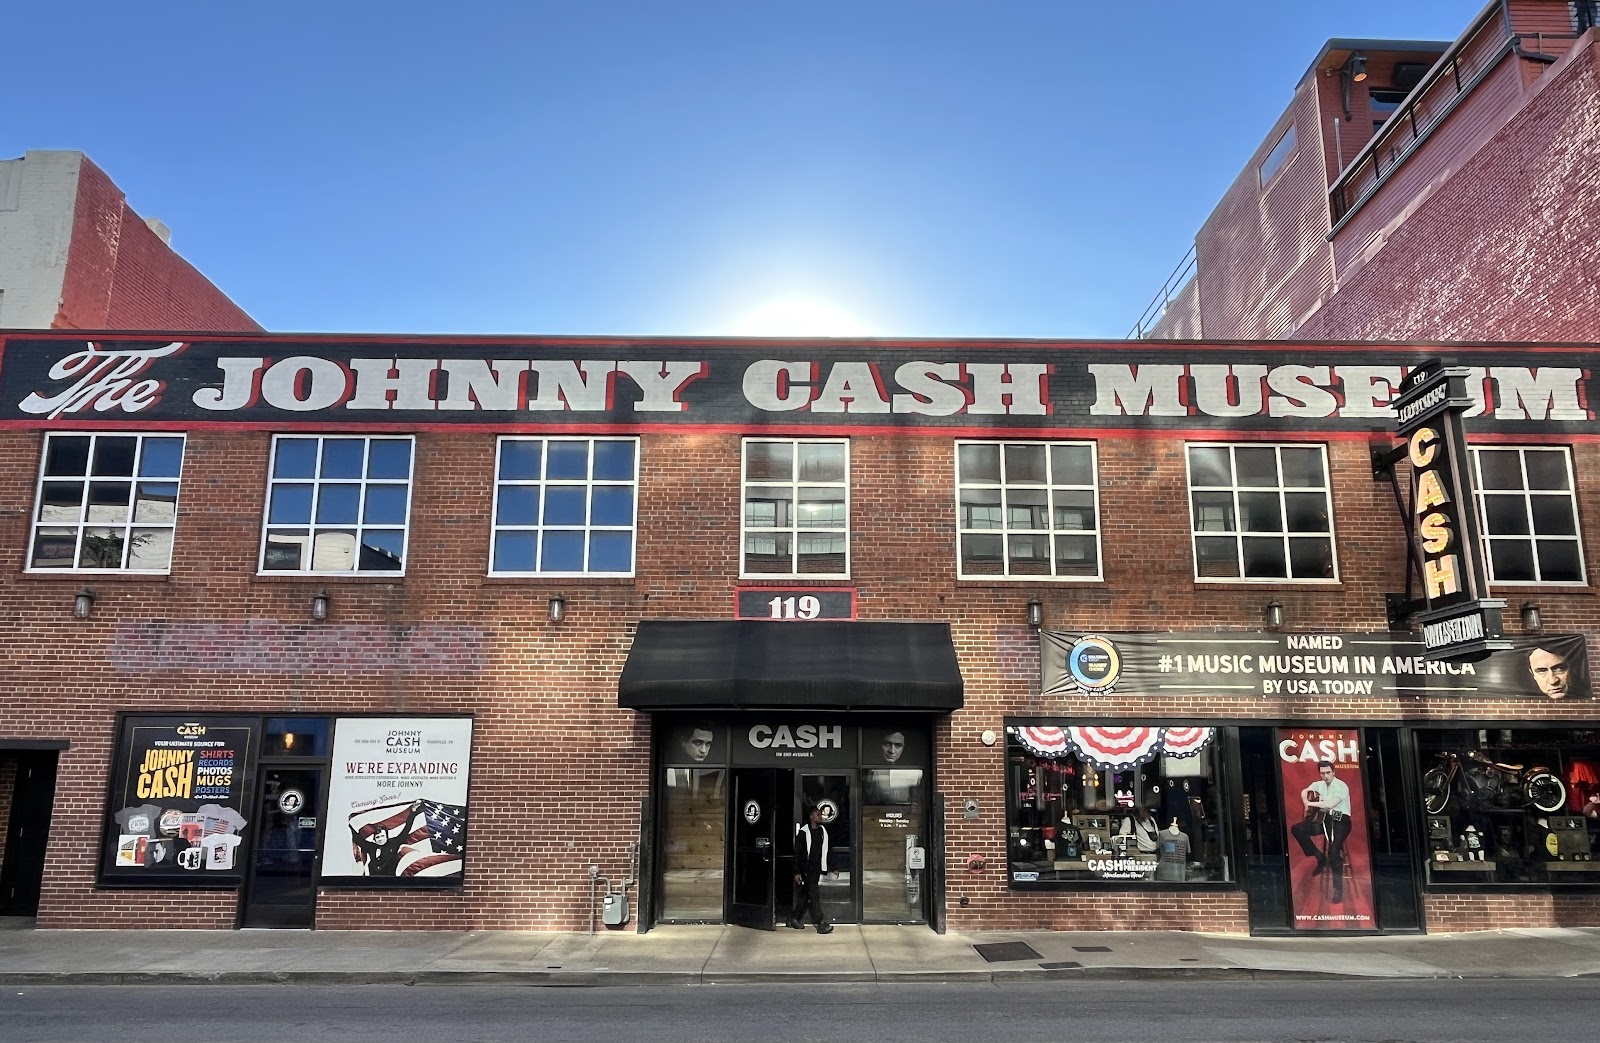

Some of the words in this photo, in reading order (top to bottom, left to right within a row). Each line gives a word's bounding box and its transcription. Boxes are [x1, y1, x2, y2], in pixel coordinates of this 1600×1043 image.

[18, 342, 183, 420] The
[192, 355, 702, 411] JOHNNY
[743, 360, 1048, 416] CASH
[1410, 427, 1460, 600] CASH
[768, 595, 820, 619] 119
[1286, 636, 1342, 650] NAMED
[1158, 655, 1183, 674] #1
[1188, 655, 1254, 674] MUSIC
[1259, 656, 1349, 674] MUSEUM
[1354, 656, 1375, 674] IN
[1381, 656, 1476, 675] AMERICA
[1262, 680, 1282, 694] BY
[1286, 680, 1318, 694] USA
[1322, 680, 1374, 694] TODAY
[177, 726, 206, 734] CASH
[748, 724, 842, 748] CASH
[386, 736, 420, 746] CASH
[200, 750, 234, 759] SHIRTS
[1279, 739, 1358, 763] CASH
[140, 750, 195, 774] JOHNNY
[346, 762, 384, 774] WE'RE
[388, 762, 458, 774] EXPANDING
[197, 767, 234, 776] PHOTOS
[136, 762, 194, 799] CASH
[196, 776, 232, 786] MUGS
[195, 786, 230, 794] POSTERS
[351, 800, 378, 809] Coming
[1088, 860, 1123, 871] CASH
